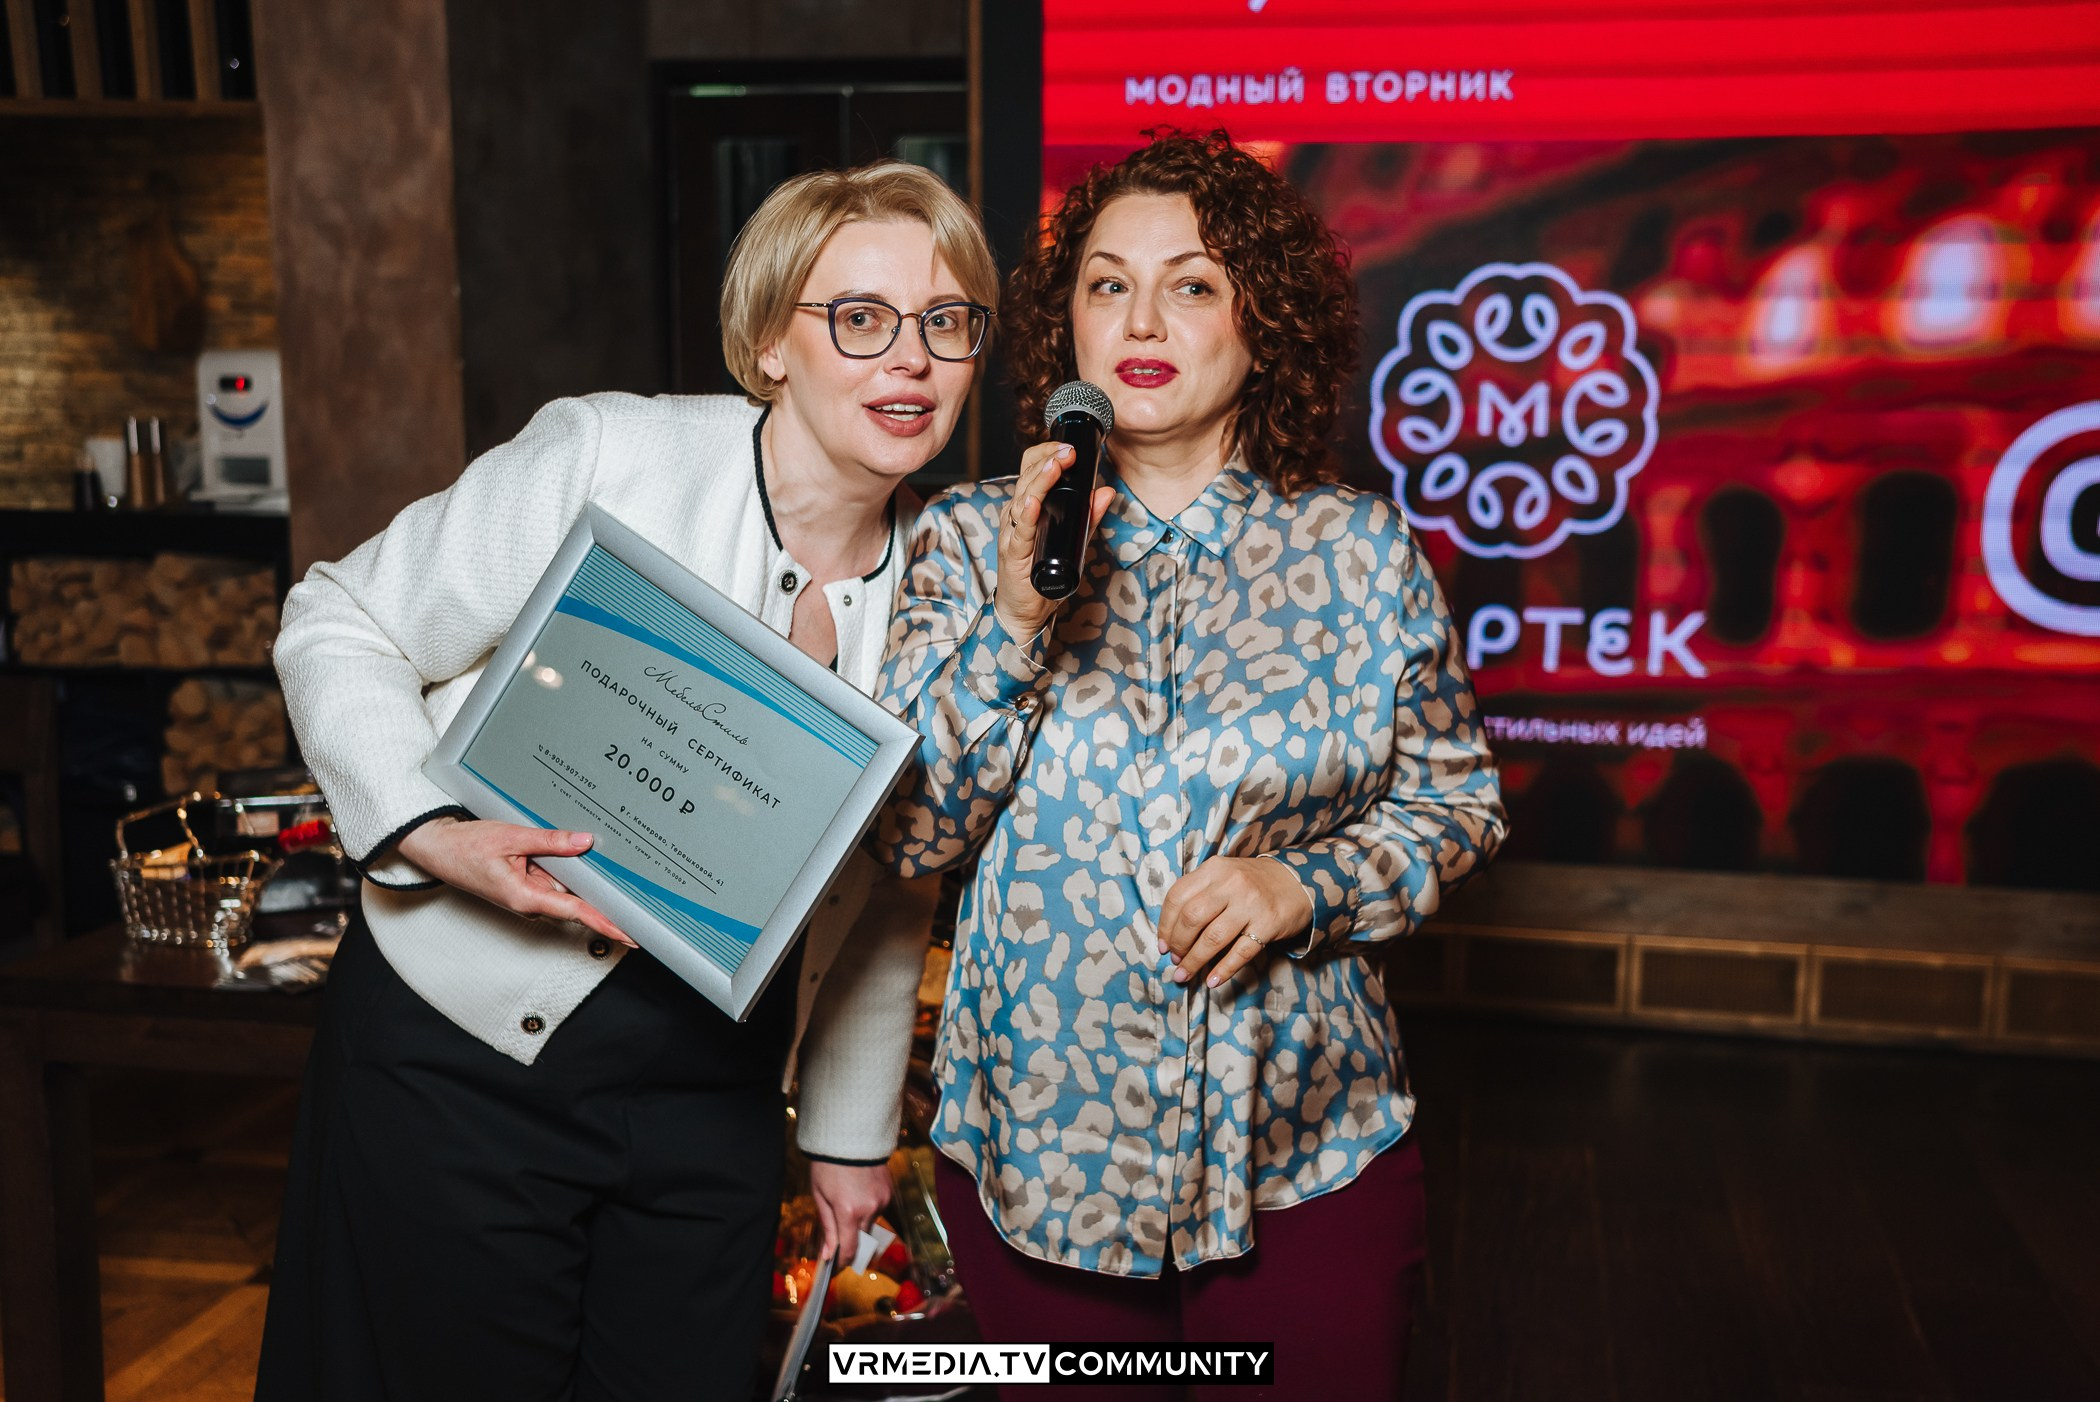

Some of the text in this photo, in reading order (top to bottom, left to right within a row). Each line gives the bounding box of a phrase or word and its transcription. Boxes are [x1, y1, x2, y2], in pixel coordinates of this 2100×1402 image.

[1124, 66, 1515, 108] МОДНЫЙ ВТОРНИК
[1465, 602, 1710, 679] РТЕК
[580, 658, 782, 810] ПОДАРОЧНЫЙ СЕРТИФИКАТ
[640, 736, 690, 774] НА СУММУ
[543, 749, 598, 791] 8-903-907-3767
[603, 743, 676, 803] 20.000
[632, 815, 669, 849] Кемерово,
[670, 842, 714, 883] Терешковой,
